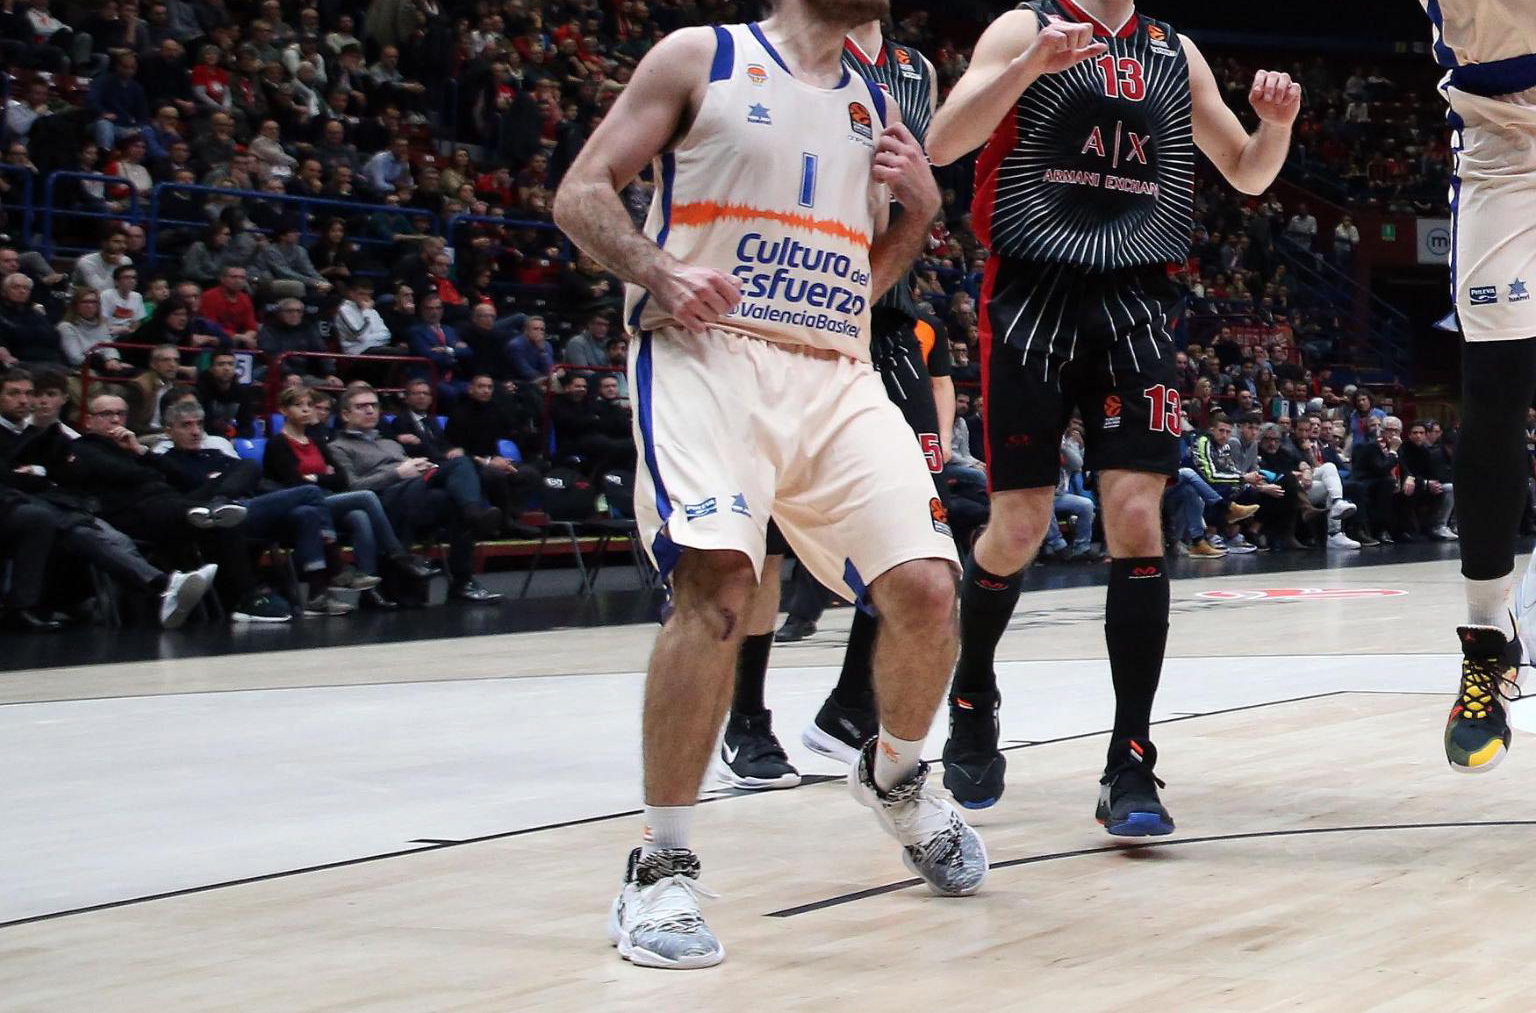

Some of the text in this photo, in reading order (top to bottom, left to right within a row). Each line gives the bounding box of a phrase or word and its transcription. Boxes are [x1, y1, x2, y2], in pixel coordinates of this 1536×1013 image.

[1096, 54, 1147, 102] 13
[798, 152, 818, 208] 1
[1043, 169, 1100, 188] ARMANI
[736, 232, 870, 287] Cultura del
[1143, 383, 1182, 437] 13
